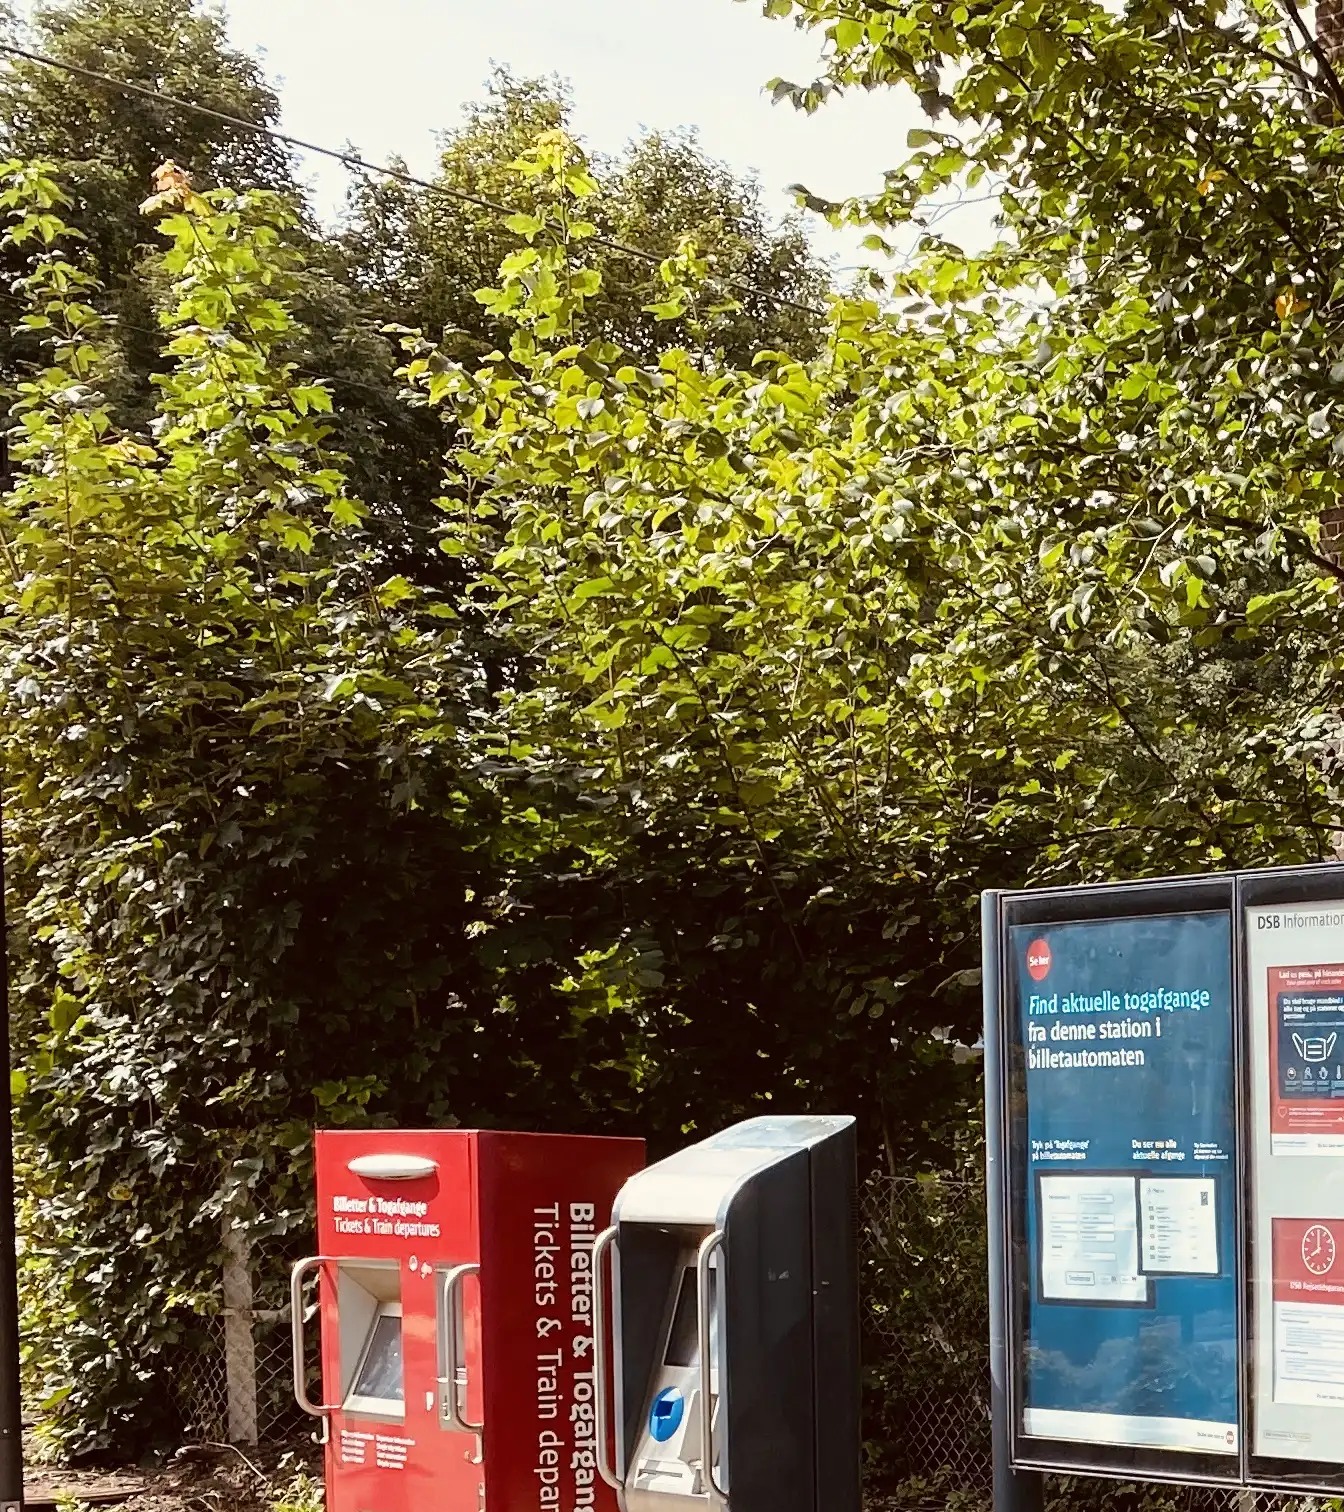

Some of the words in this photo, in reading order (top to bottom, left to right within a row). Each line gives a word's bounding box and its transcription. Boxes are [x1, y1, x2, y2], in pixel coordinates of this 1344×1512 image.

[1258, 915, 1280, 929] DSB
[1029, 955, 1038, 967] Se
[1038, 954, 1049, 965] her
[1029, 993, 1058, 1015] Find
[1062, 990, 1120, 1013] aktuelle
[1124, 987, 1210, 1013] togafgange
[1028, 1021, 1047, 1042] fra
[1050, 1020, 1096, 1041] denne
[1099, 1018, 1152, 1039] station
[1156, 1017, 1161, 1037] i
[1028, 1048, 1145, 1069] billetautomaten
[333, 1196, 368, 1212] Billetter
[369, 1197, 376, 1213] &
[376, 1197, 427, 1218] Togafgange
[334, 1216, 363, 1234] Tickets
[364, 1217, 371, 1234] &
[372, 1218, 393, 1234] Train
[394, 1219, 440, 1240] departures
[534, 1202, 561, 1306] Tickets
[570, 1202, 596, 1326] Billetter
[536, 1317, 562, 1338] &
[572, 1335, 594, 1358] &
[537, 1348, 564, 1419] Train
